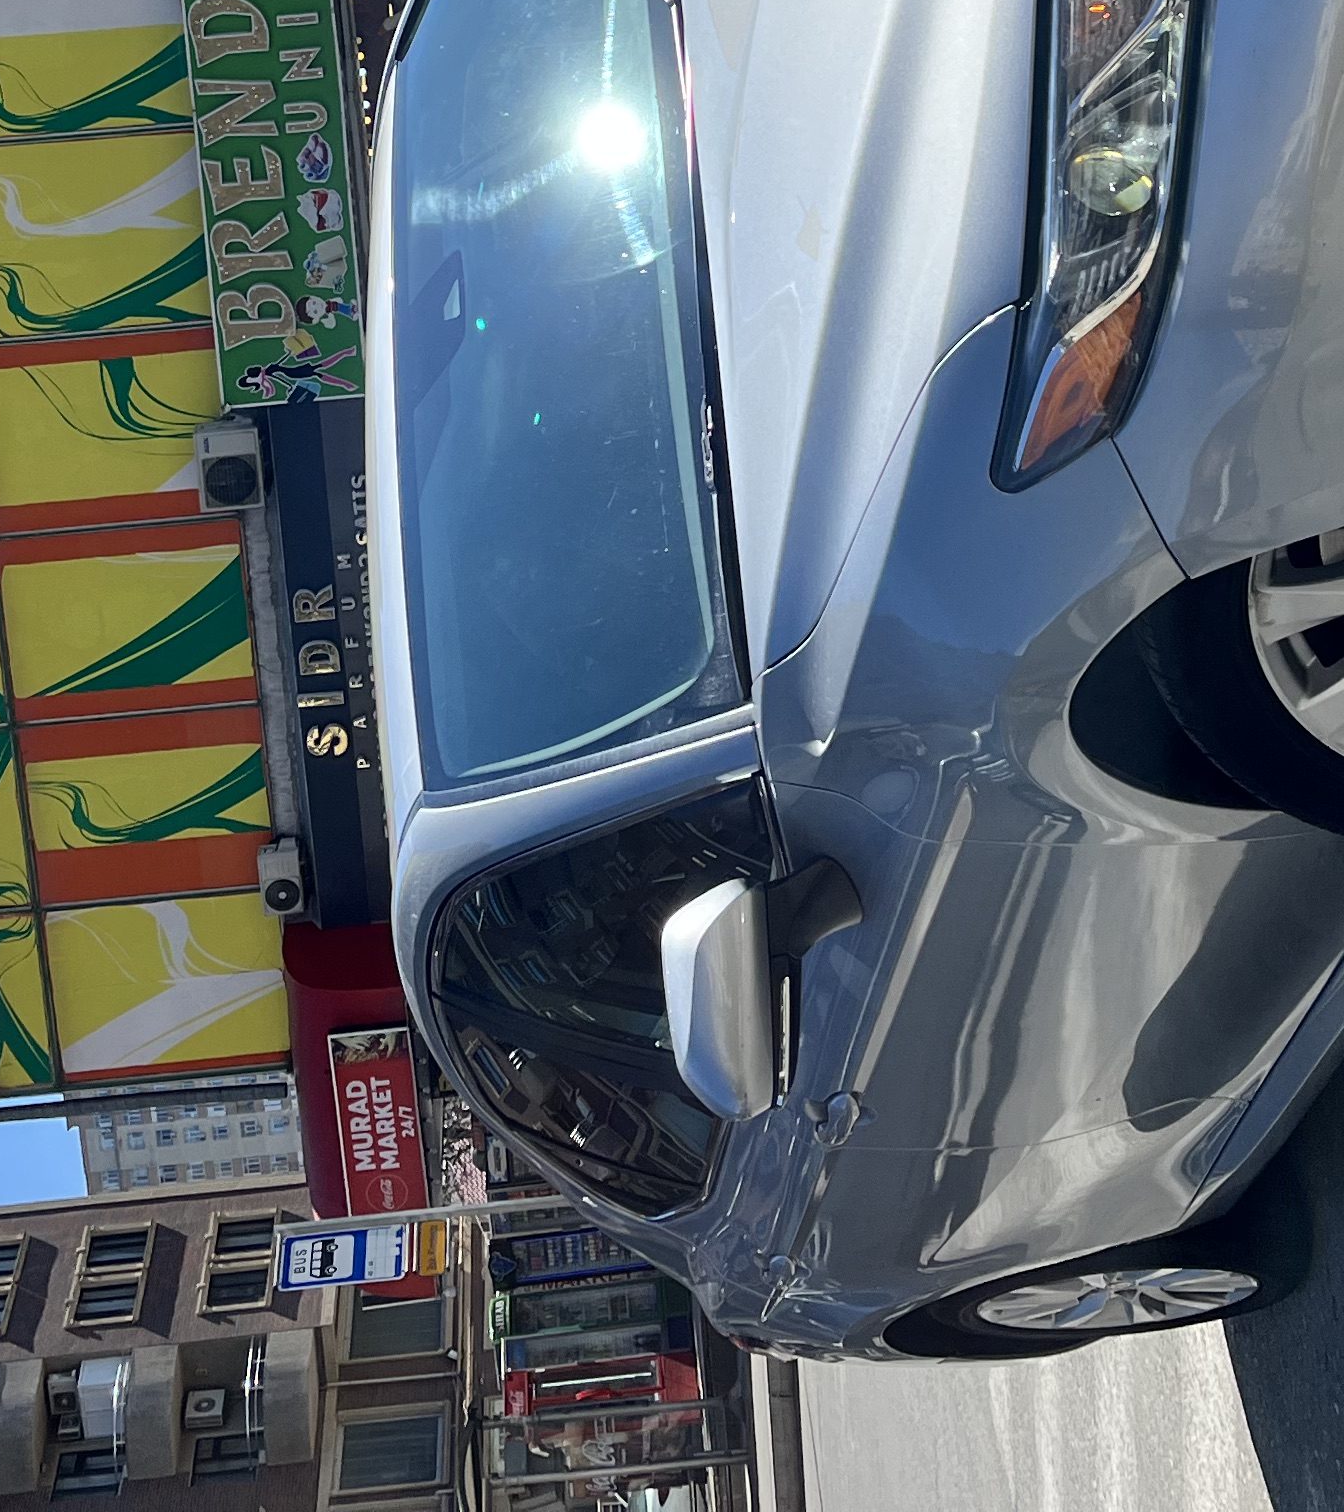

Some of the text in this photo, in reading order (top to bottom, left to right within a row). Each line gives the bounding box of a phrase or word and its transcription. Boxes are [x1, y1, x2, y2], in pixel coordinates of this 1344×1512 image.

[337, 552, 370, 769] PARFUM
[345, 1079, 377, 1172] MURAD
[370, 1076, 401, 1170] MARKET
[398, 1106, 416, 1138] 24/7
[293, 1248, 307, 1274] BUS
